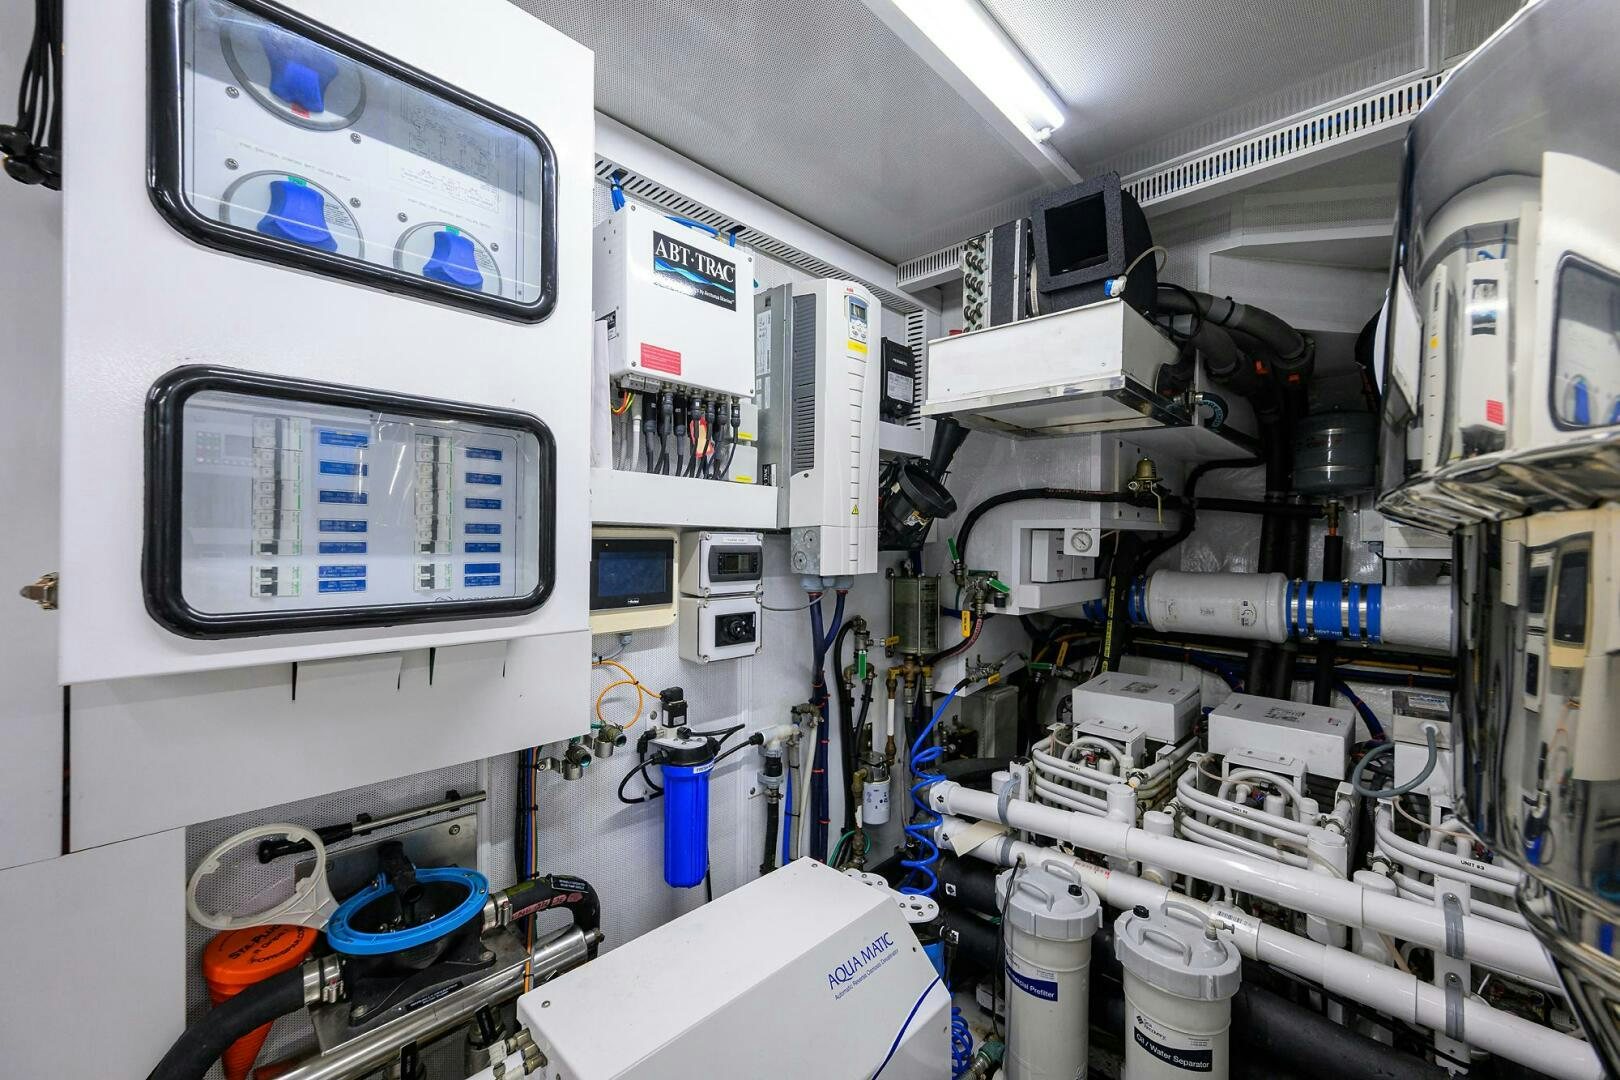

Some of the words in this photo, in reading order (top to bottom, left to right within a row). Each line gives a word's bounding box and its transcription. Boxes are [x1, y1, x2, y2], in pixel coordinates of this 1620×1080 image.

[1460, 859, 1475, 868] UNIT
[828, 955, 863, 990] AQUA
[860, 931, 894, 965] MATIC
[834, 985, 854, 1001] Automatic
[852, 974, 868, 987] Reverse
[1029, 985, 1055, 999] Prefilter
[1136, 1032, 1145, 1044] Oil
[1150, 1043, 1171, 1060] Water
[1172, 1055, 1210, 1069] Separator
